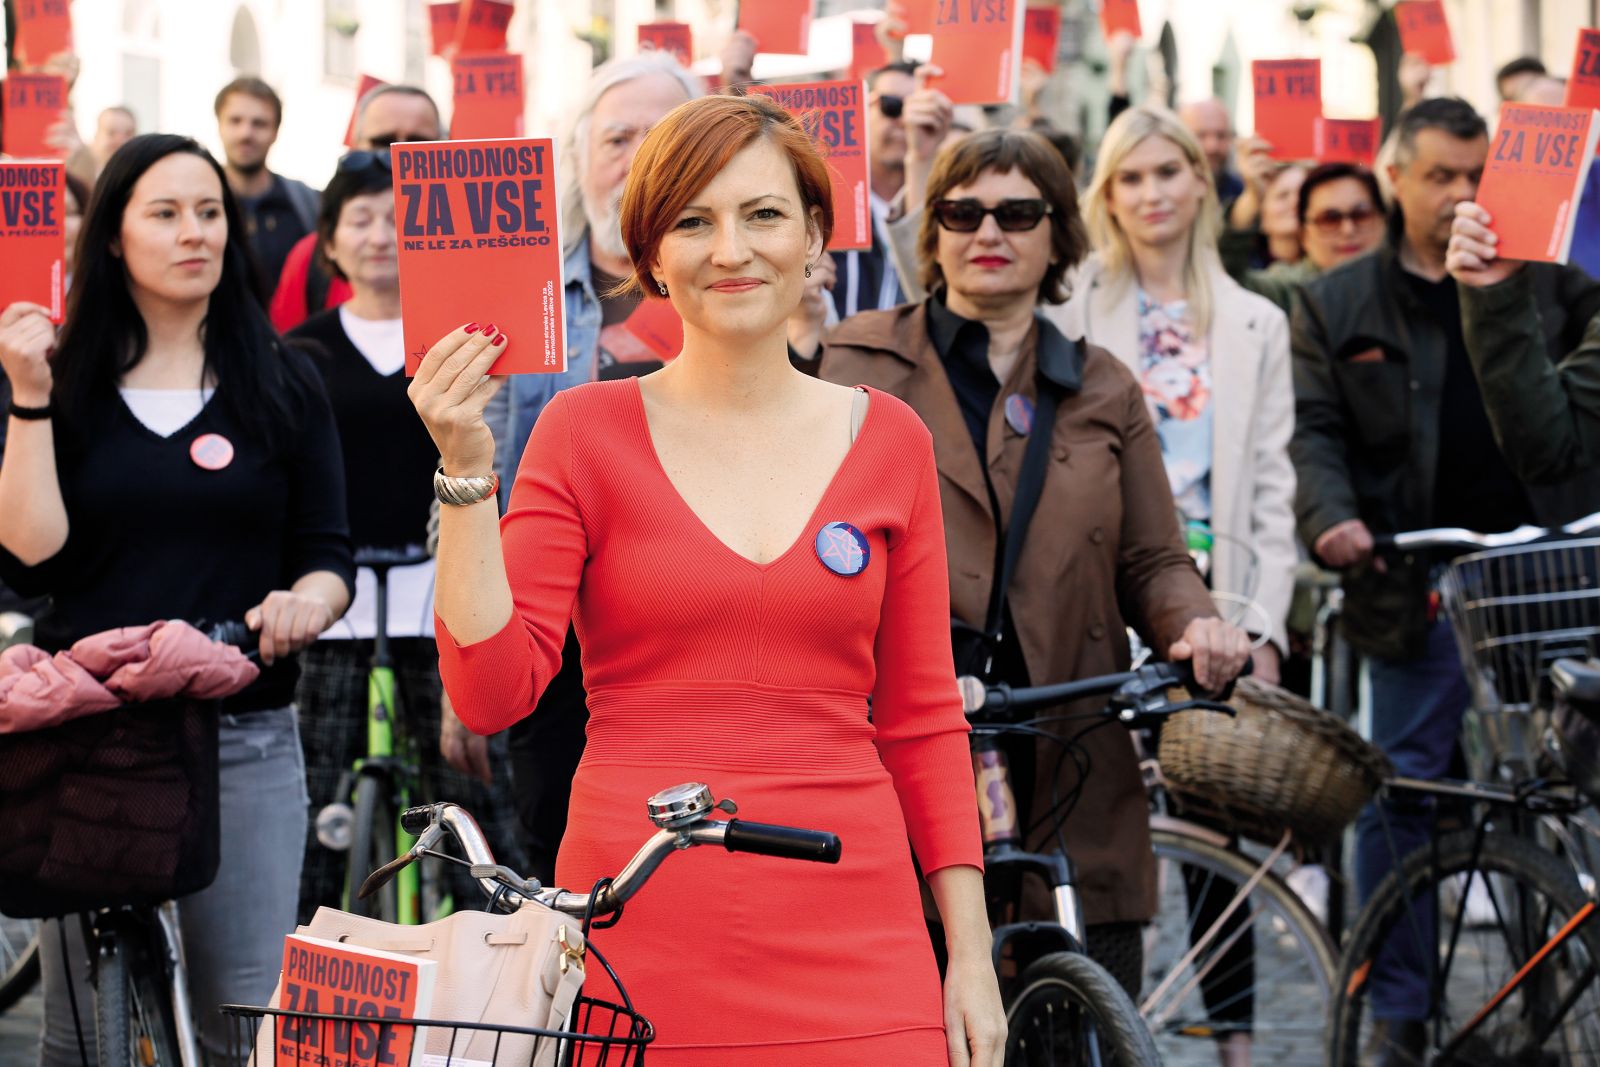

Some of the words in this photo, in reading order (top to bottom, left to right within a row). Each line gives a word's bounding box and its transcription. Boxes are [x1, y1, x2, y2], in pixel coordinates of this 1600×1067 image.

[399, 146, 545, 180] PRIHODNOST
[1495, 129, 1525, 162] ZA
[1534, 133, 1579, 168] VSE
[2, 191, 56, 226] VSE
[401, 183, 455, 237] ZA
[463, 180, 550, 235] VSE,
[404, 240, 424, 251] NE
[428, 240, 446, 250] LE
[450, 239, 472, 249] ZA
[477, 235, 550, 249] PEŠČICO
[288, 946, 411, 1003] PRIHODNOST
[281, 983, 319, 1048] ZA
[280, 1044, 295, 1057] NE
